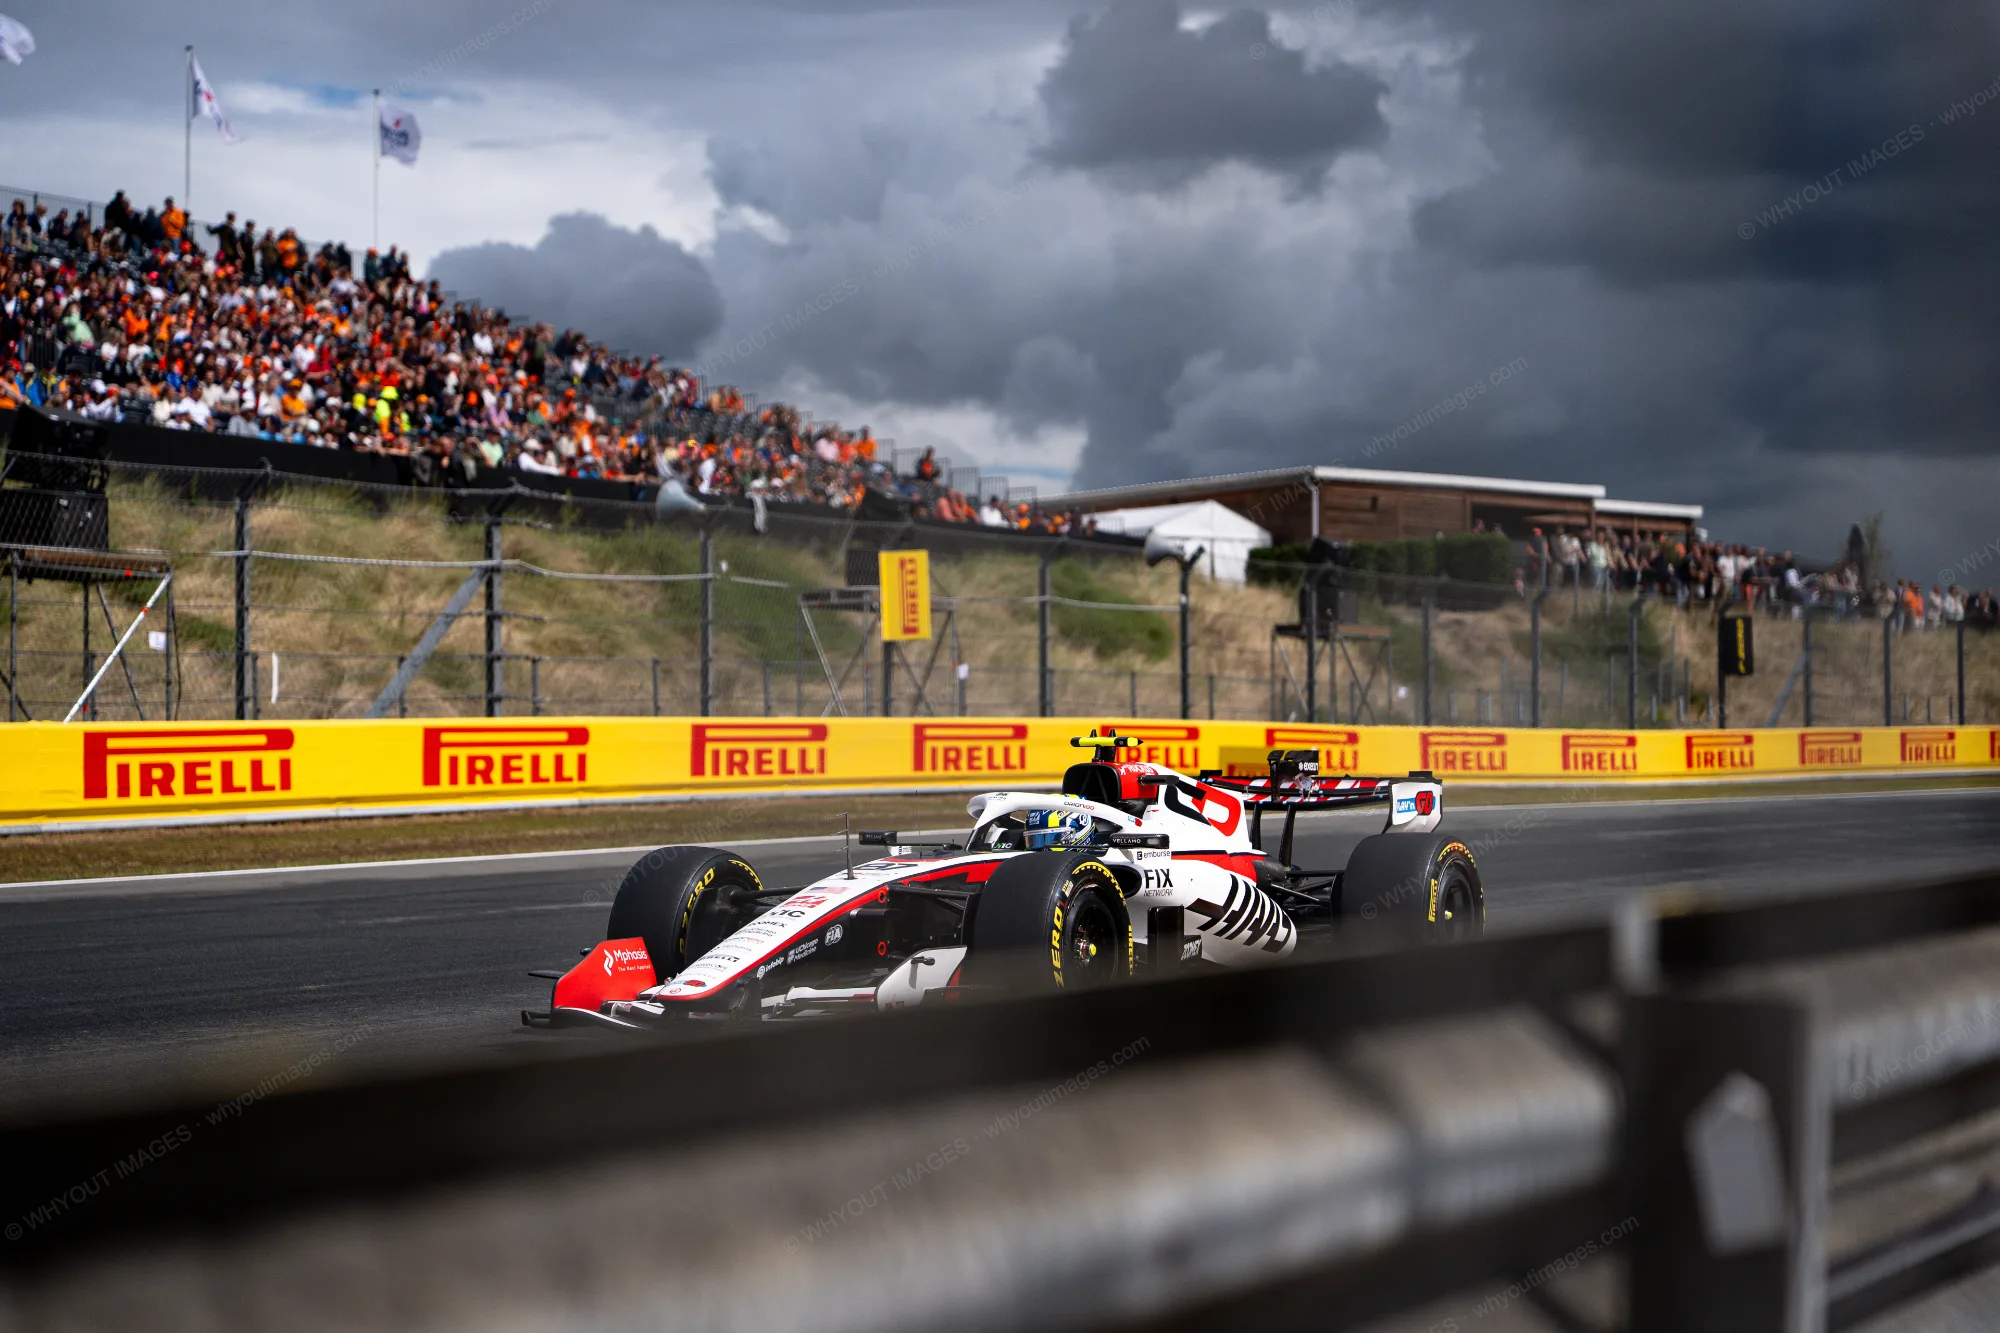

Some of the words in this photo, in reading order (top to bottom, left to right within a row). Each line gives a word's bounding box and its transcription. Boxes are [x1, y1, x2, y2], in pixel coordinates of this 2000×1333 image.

[899, 558, 919, 635] PIRELLI
[83, 727, 295, 800] PIRELLI
[423, 726, 590, 787] PIRELLI
[691, 724, 828, 777] PIRELLI
[913, 724, 1029, 772] PIRELLI
[1420, 732, 1507, 772] PIRELLI
[1562, 735, 1638, 772] PIRELLI
[1685, 734, 1754, 769] PIRELLI
[1798, 732, 1862, 766] PIRELLI
[1900, 731, 1956, 762] PIRELLI
[1143, 868, 1174, 889] FIX
[1143, 889, 1174, 897] NETWORK
[825, 926, 842, 943] FIA
[613, 948, 648, 965] Mphasis
